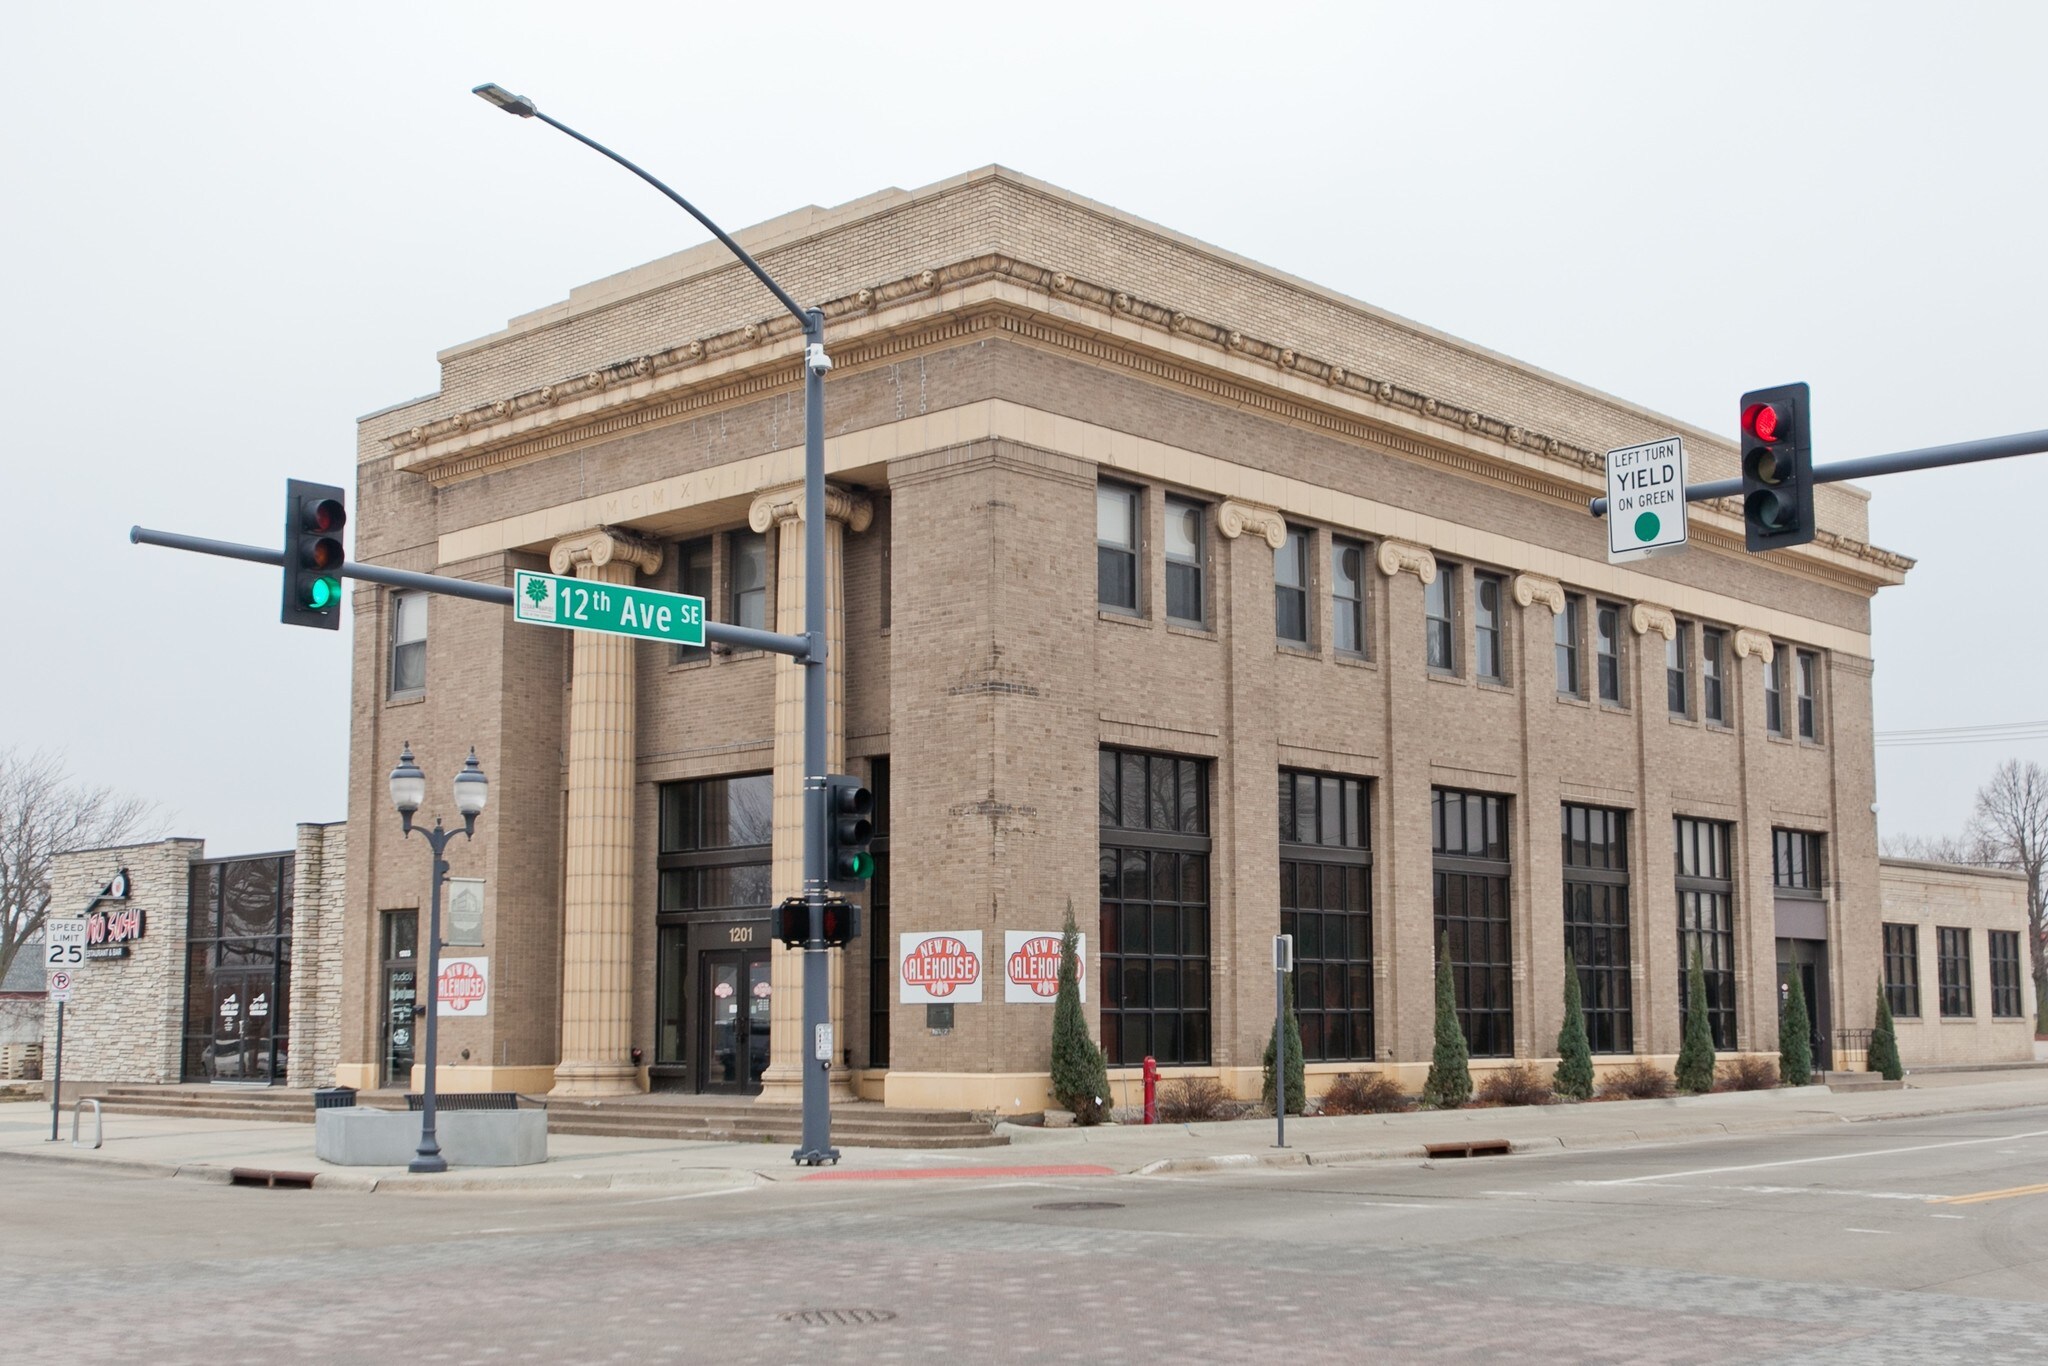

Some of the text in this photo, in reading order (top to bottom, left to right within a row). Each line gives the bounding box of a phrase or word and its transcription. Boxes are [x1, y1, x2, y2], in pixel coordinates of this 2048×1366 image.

[1615, 444, 1674, 468] LEFT TURN
[1617, 464, 1674, 491] YIELD
[1619, 489, 1674, 511] ON GREEN
[561, 587, 700, 632] 12th Ave SE
[50, 923, 84, 932] SPEED
[107, 908, 140, 942] SUSHI
[729, 927, 752, 942] 1201
[53, 934, 80, 942] LIMIT
[1026, 939, 1062, 957] NEW B
[49, 945, 82, 963] 25
[920, 939, 961, 958] NEW BO
[909, 956, 973, 980] ALEHOUSE
[1014, 956, 1062, 979] ALEHOU
[437, 978, 481, 997] ALEHOUSE
